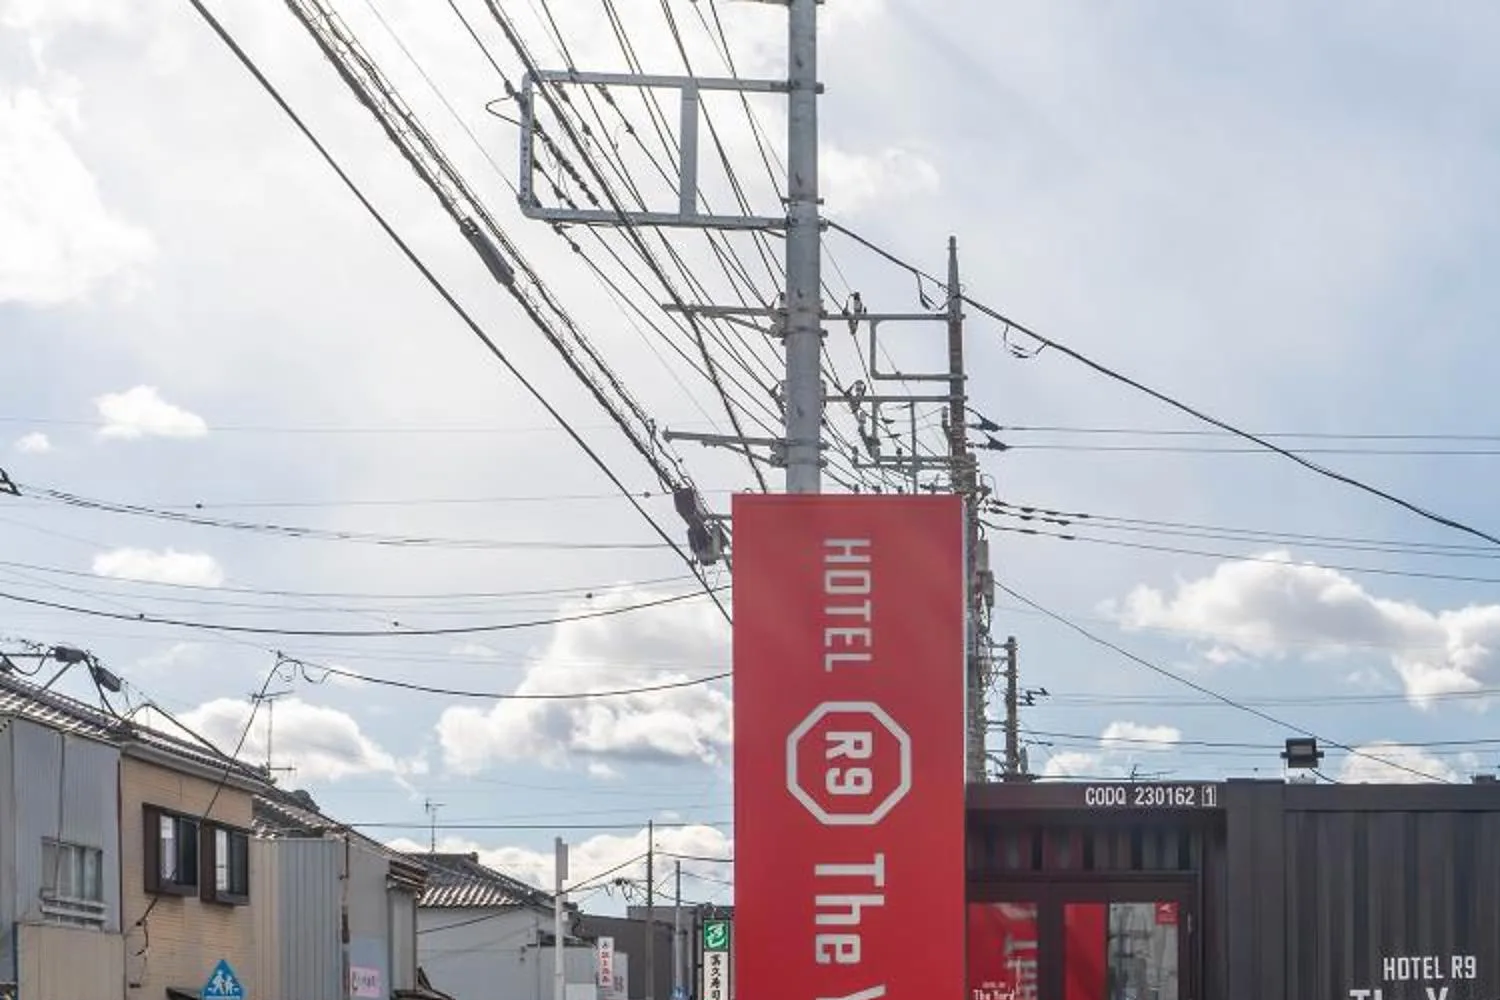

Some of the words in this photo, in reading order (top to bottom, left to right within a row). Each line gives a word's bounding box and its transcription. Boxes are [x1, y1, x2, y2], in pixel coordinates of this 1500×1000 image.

[824, 538, 872, 672] HOTEL
[825, 731, 872, 795] R9
[1085, 786, 1127, 805] CODQ
[1134, 786, 1195, 805] 230162
[814, 852, 885, 964] The
[1383, 956, 1444, 981] HOTEL
[1451, 955, 1477, 979] R9
